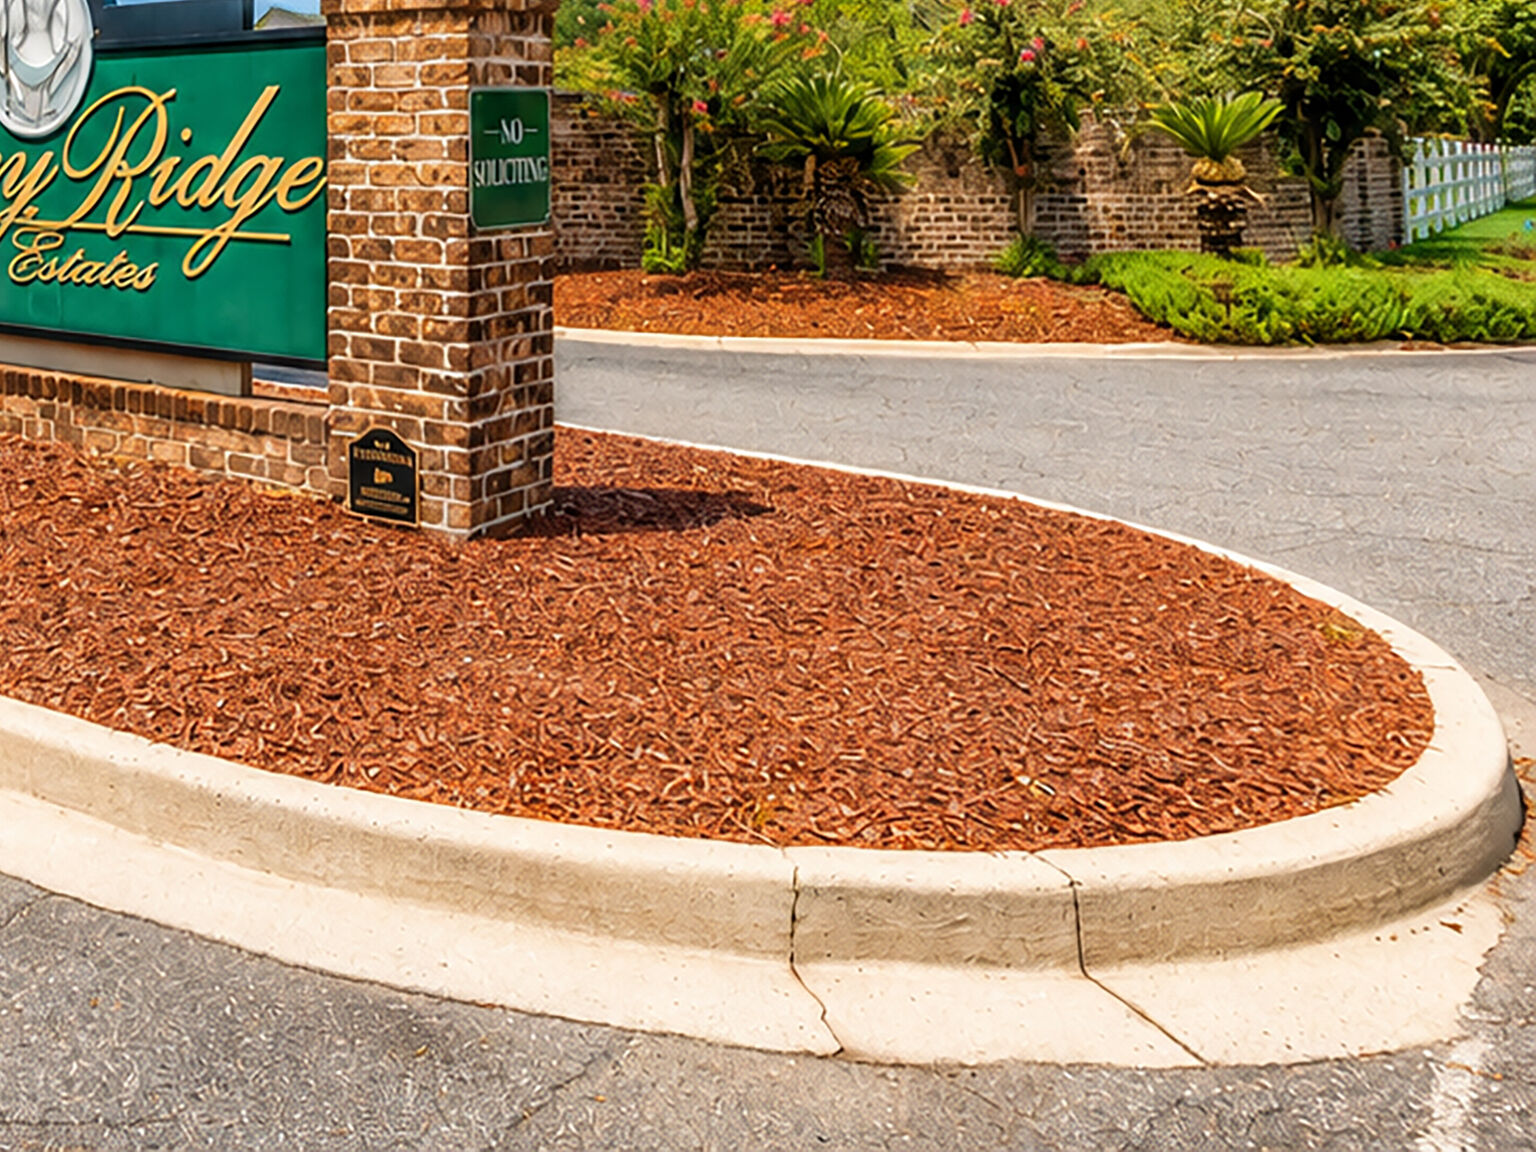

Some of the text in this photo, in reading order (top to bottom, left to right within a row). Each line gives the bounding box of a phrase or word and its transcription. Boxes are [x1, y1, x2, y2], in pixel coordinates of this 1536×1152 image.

[45, 84, 326, 278] Ridge
[474, 156, 548, 187] SOLICITING
[8, 228, 157, 291] Estates
